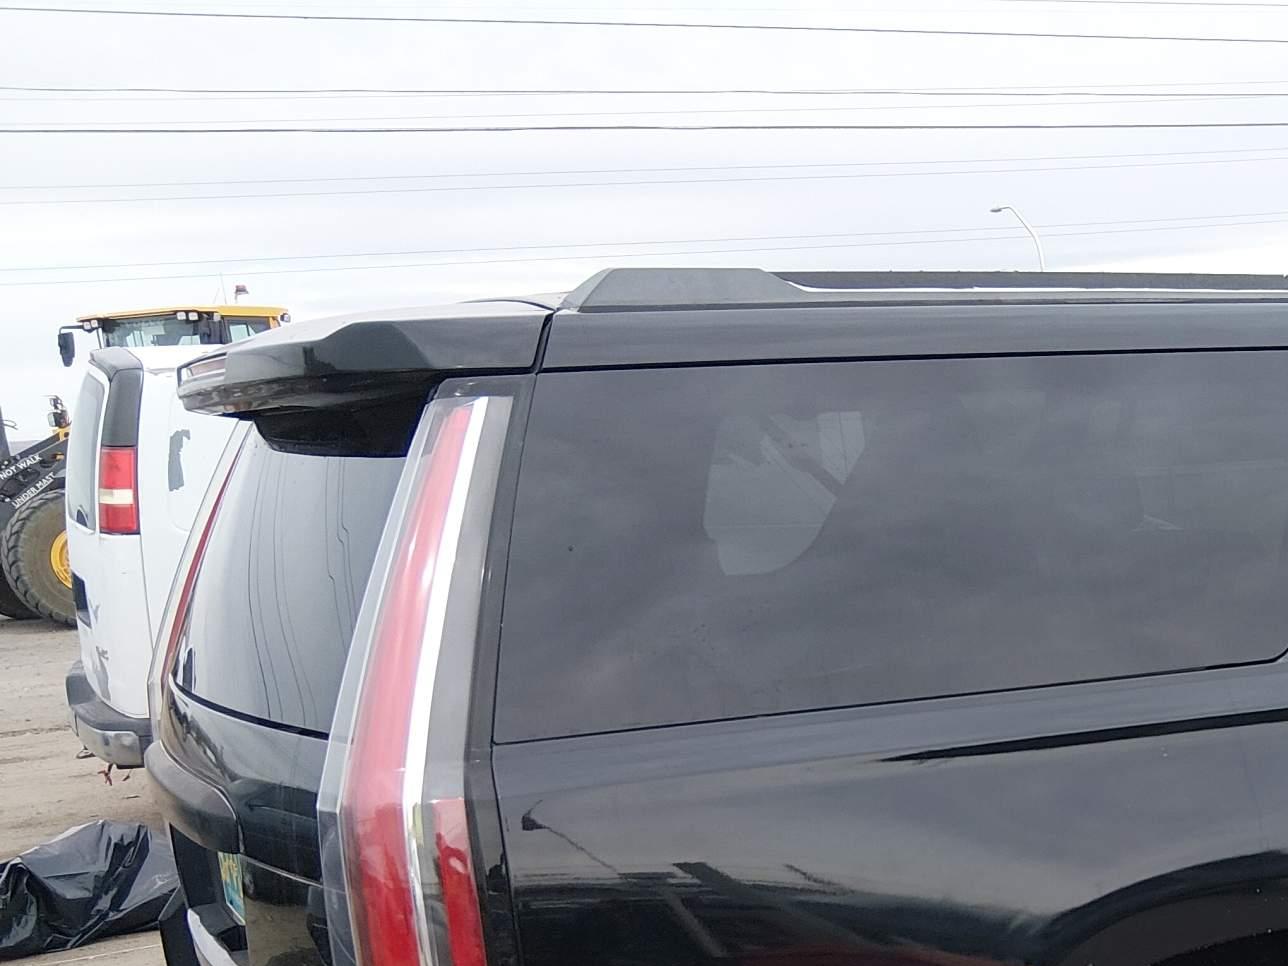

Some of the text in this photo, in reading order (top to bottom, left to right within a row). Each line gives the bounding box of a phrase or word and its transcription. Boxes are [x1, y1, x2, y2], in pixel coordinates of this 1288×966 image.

[16, 453, 43, 470] WALK
[11, 471, 56, 510] UNDER MAST
